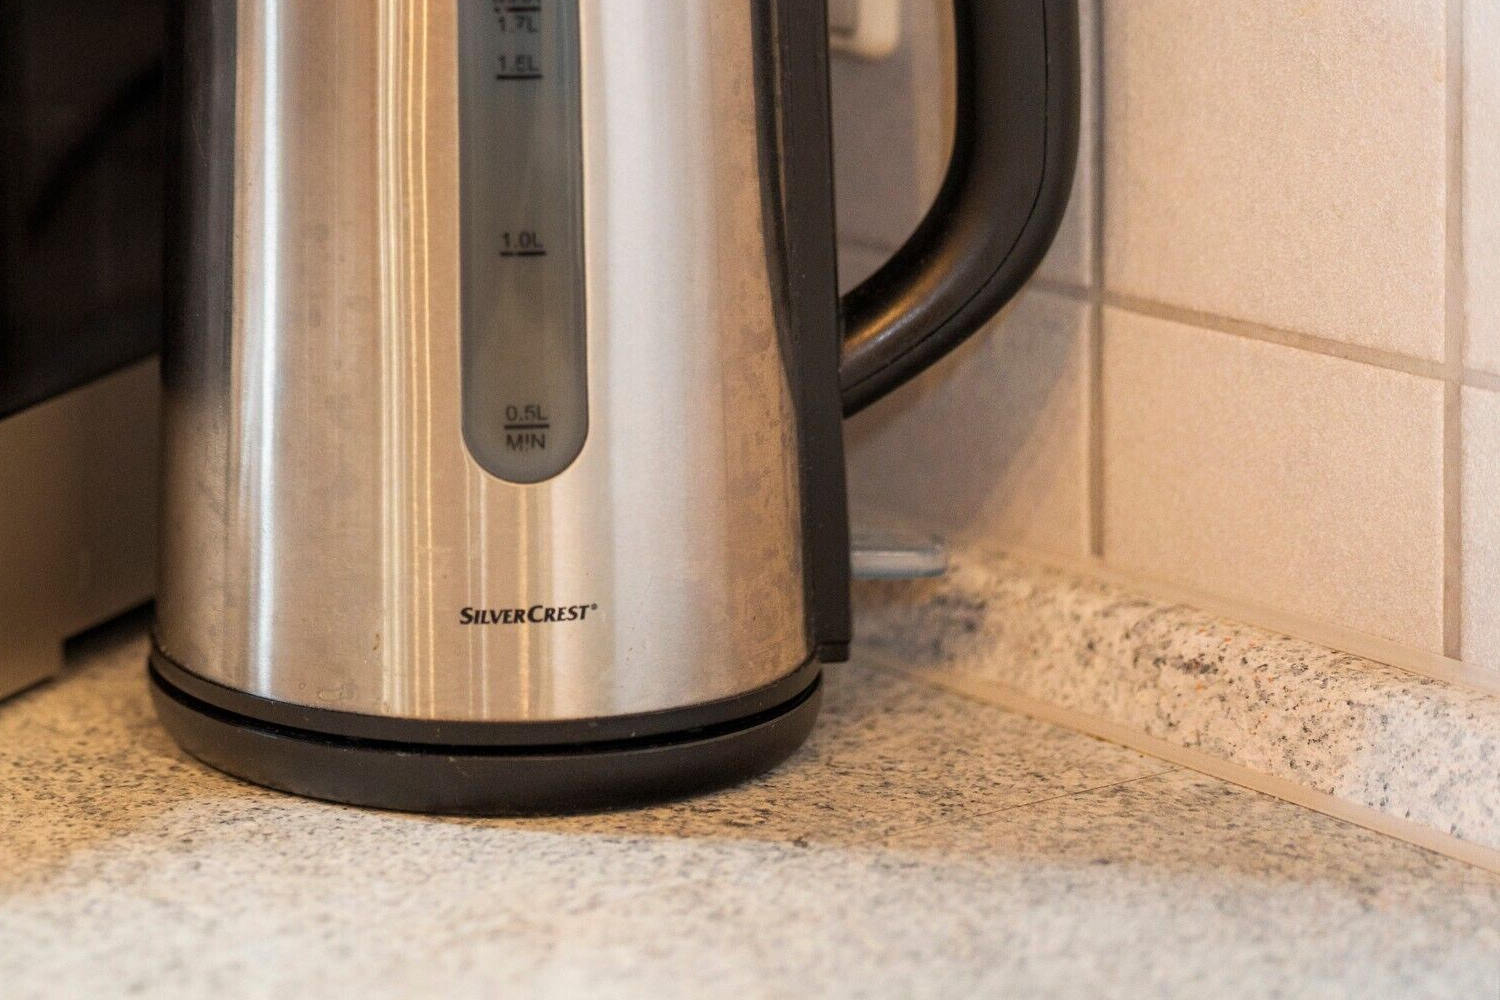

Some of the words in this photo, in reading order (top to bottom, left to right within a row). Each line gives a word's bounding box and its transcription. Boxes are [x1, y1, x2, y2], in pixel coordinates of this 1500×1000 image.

[502, 232, 543, 248] 1.0L
[505, 404, 548, 421] 0.5L
[505, 433, 546, 450] MIN
